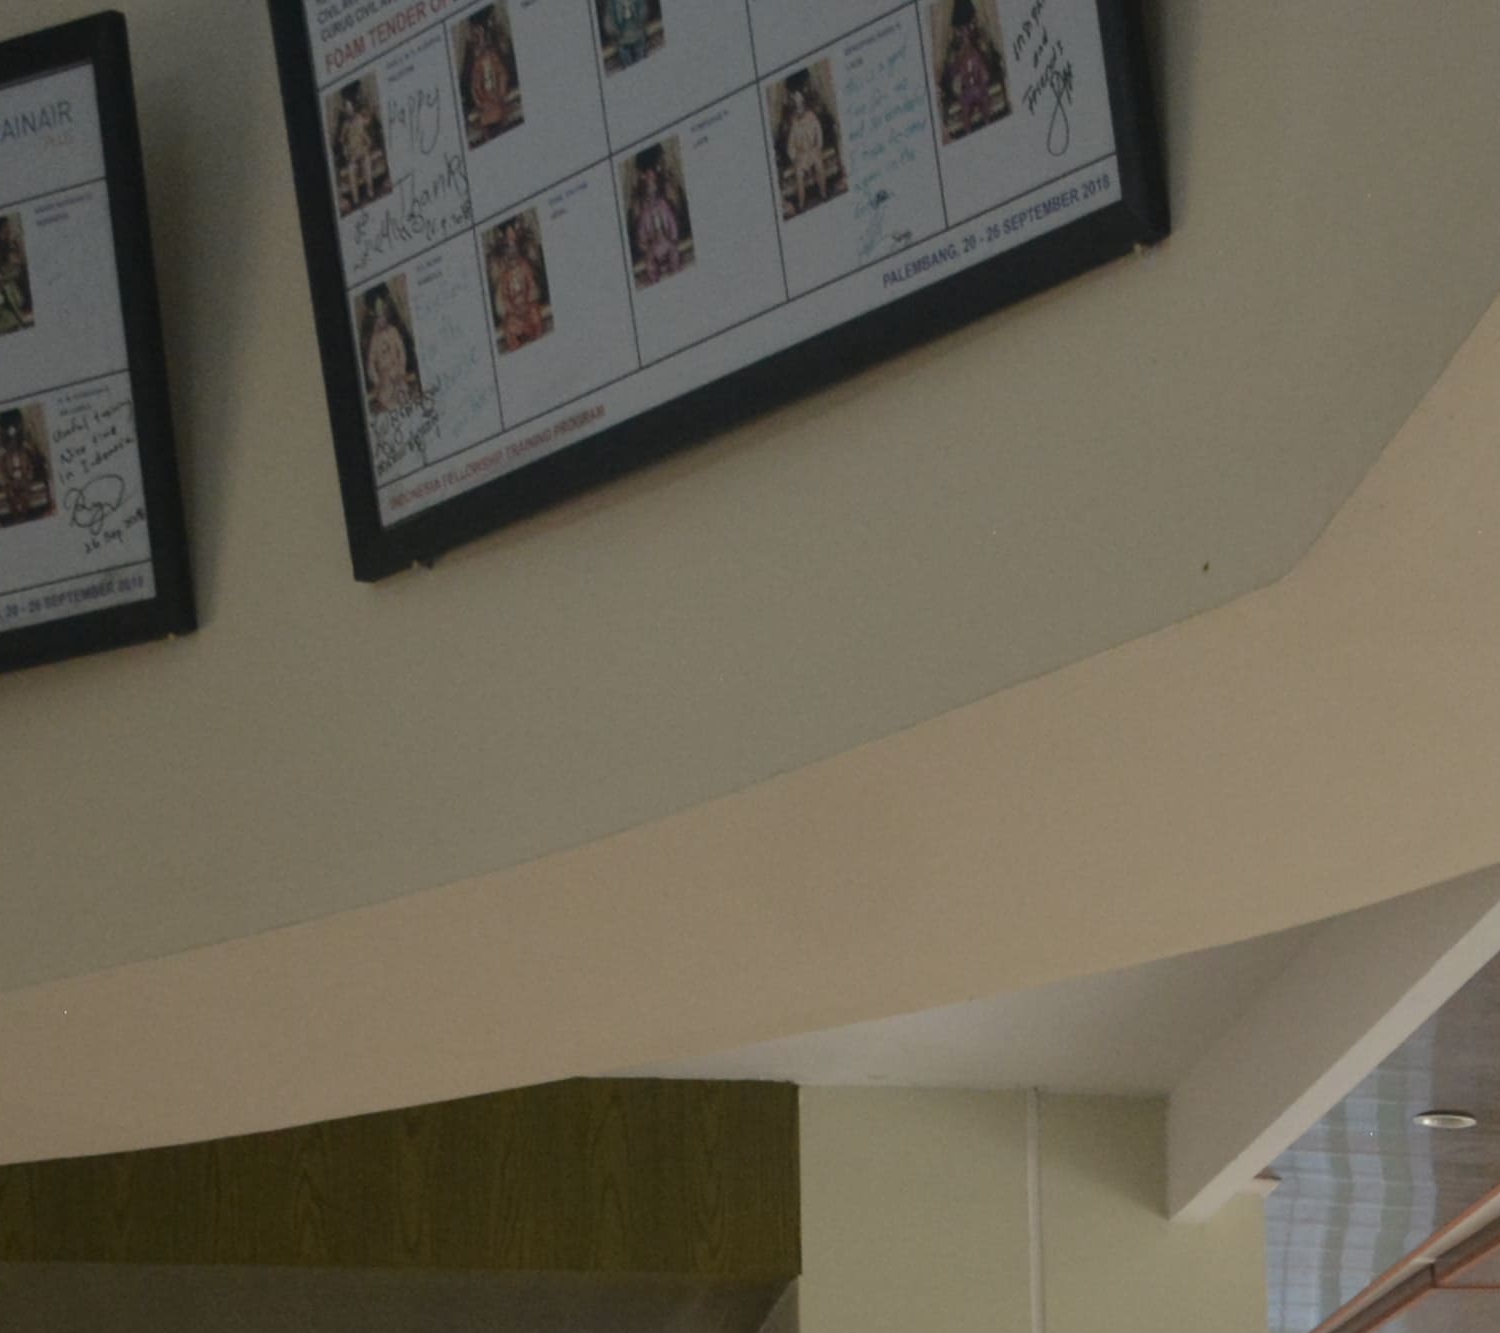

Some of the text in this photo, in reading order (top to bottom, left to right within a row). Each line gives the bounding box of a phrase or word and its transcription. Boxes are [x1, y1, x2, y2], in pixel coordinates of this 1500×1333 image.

[324, 34, 367, 75] FOAM
[367, 0, 428, 48] TENDER
[1002, 187, 1080, 236] SEPTEMBER
